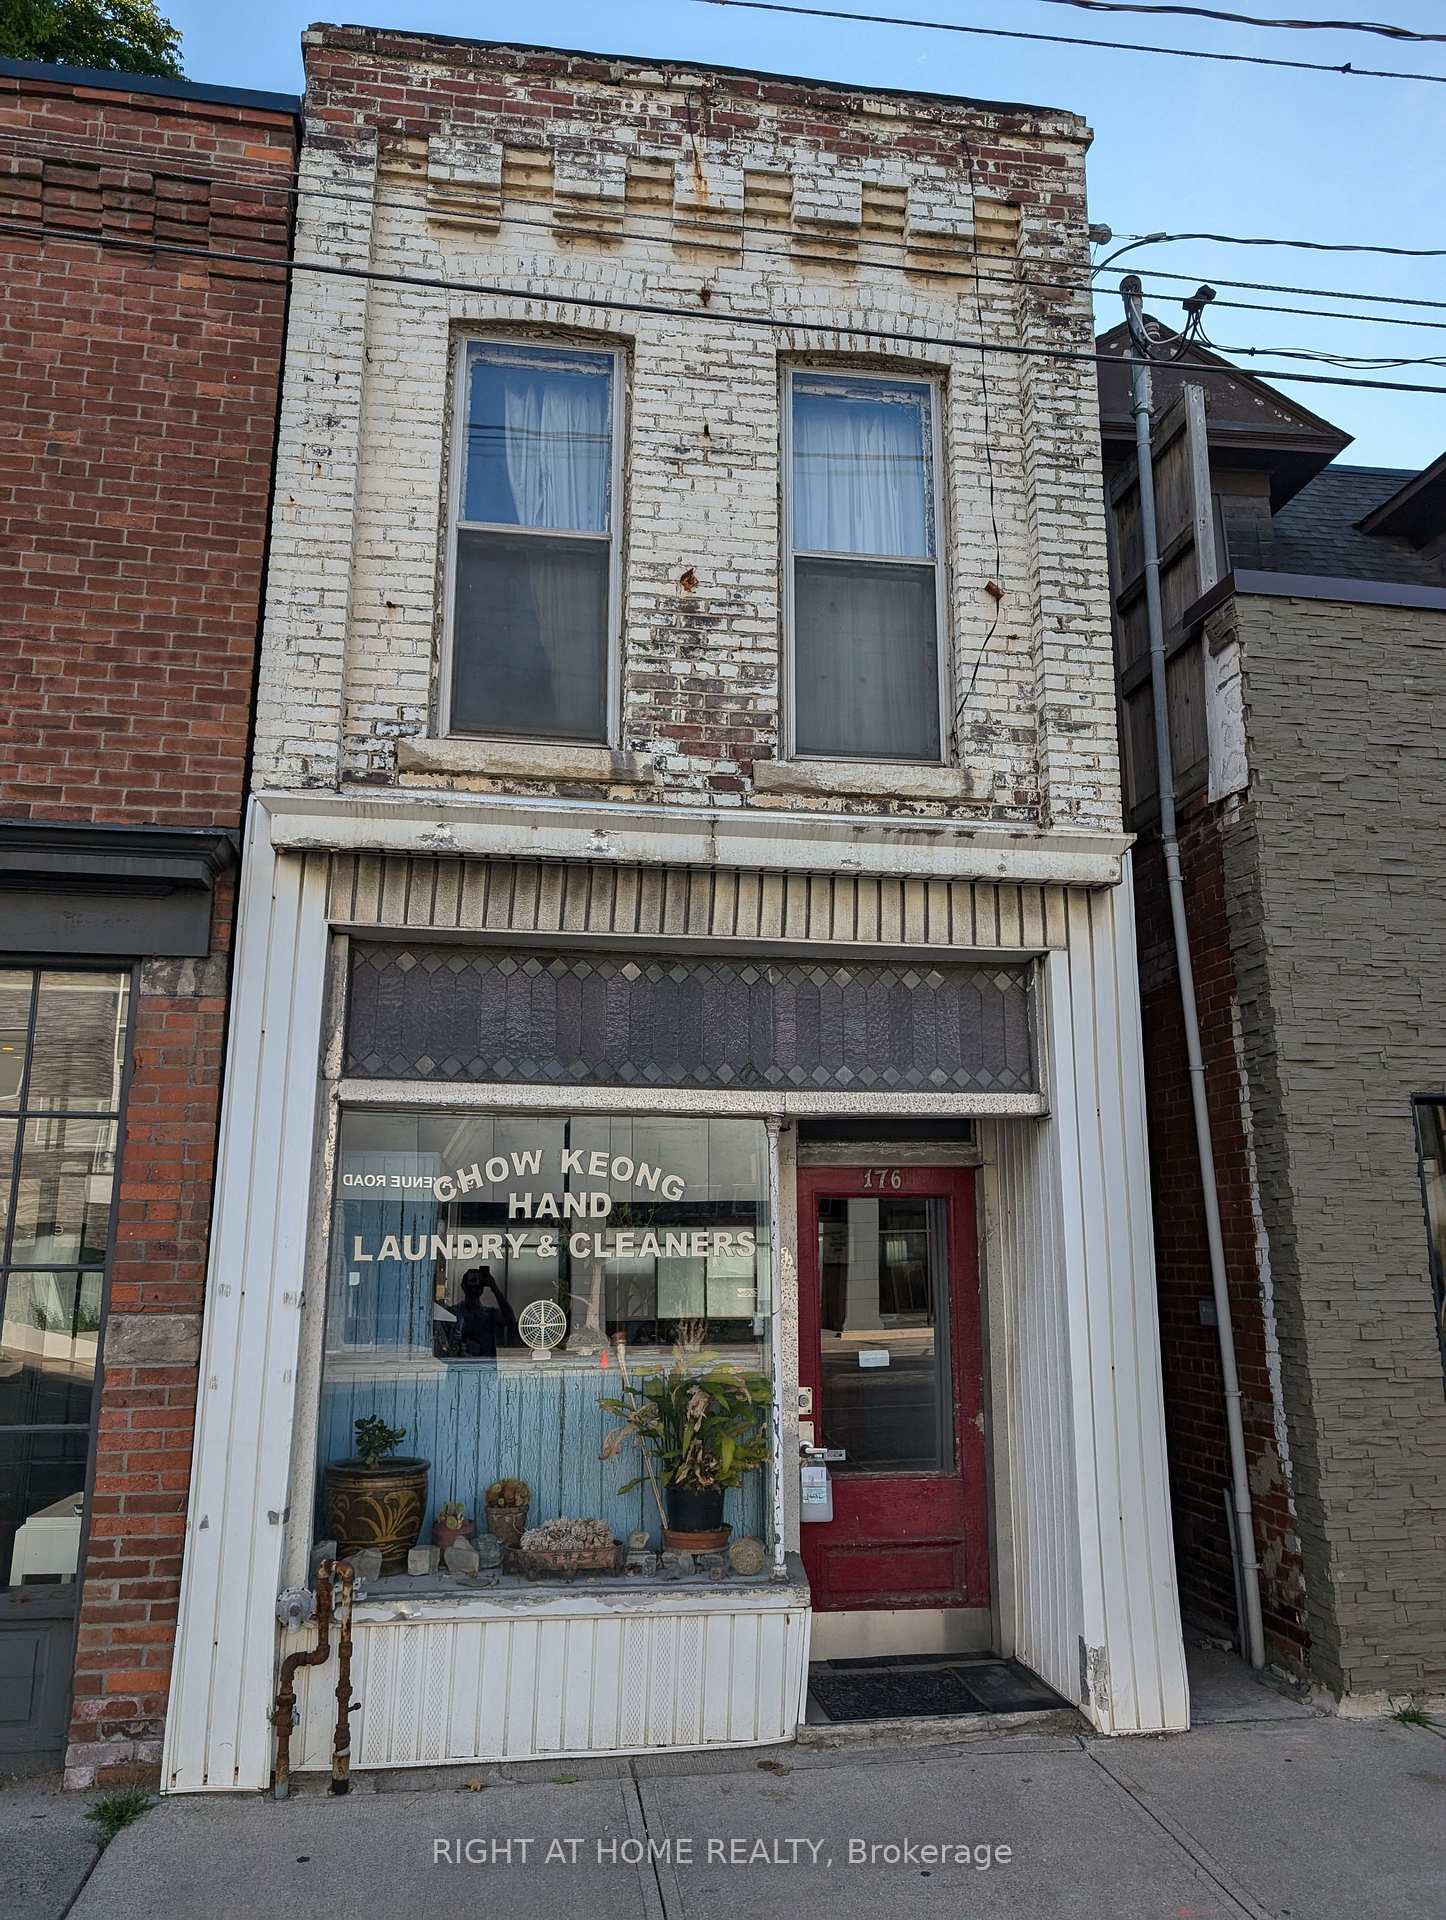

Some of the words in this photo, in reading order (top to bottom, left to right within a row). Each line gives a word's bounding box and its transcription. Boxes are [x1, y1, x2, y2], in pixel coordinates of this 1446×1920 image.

[433, 1150, 543, 1202] CHOW
[560, 1148, 686, 1201] KEONG
[863, 1168, 902, 1190] 176
[508, 1191, 612, 1219] HAND
[353, 1233, 529, 1262] LAUNDRY
[535, 1234, 558, 1258] &
[568, 1231, 756, 1259] CLEANERS
